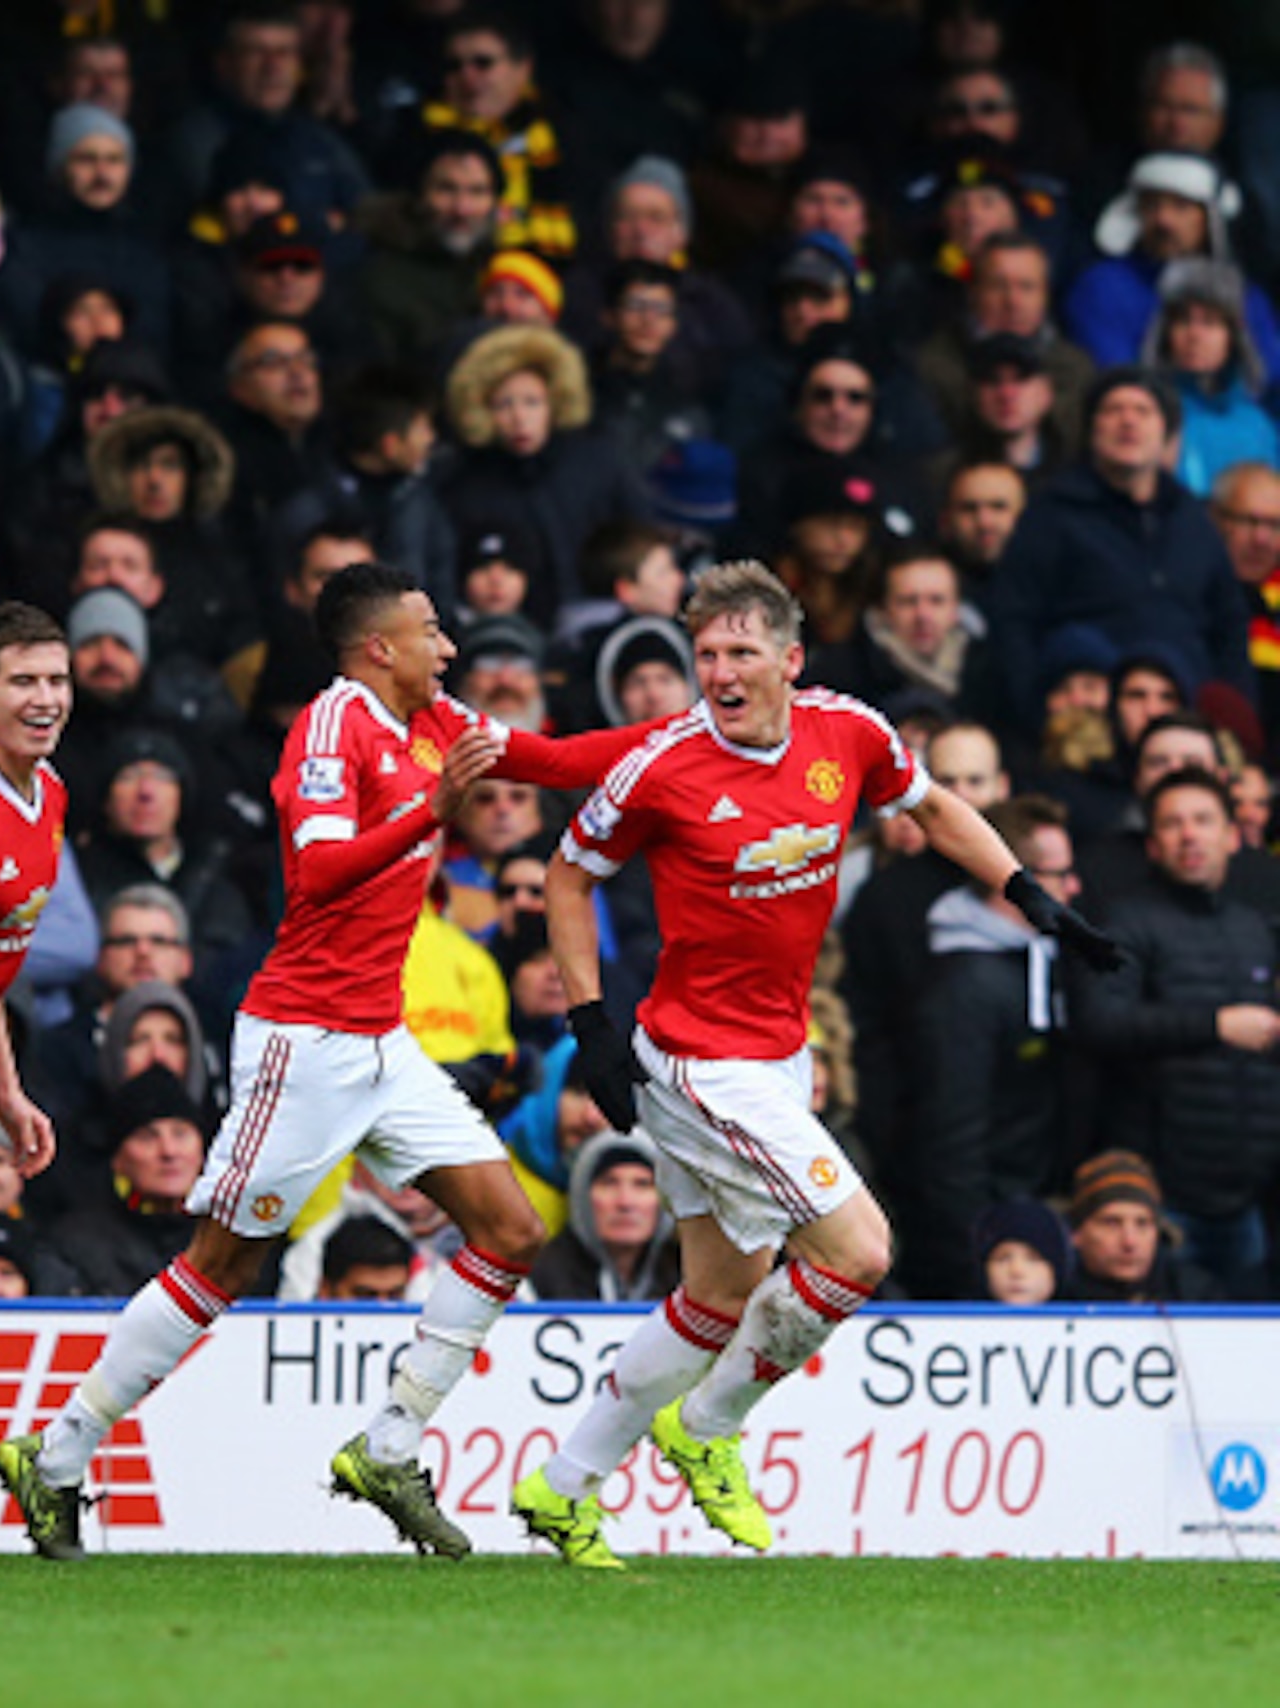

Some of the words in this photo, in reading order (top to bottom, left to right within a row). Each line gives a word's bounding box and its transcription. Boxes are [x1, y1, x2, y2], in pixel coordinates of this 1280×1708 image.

[861, 1318, 1177, 1408] Service
[597, 1430, 804, 1516] 895
[843, 1428, 1045, 1516] 1100
